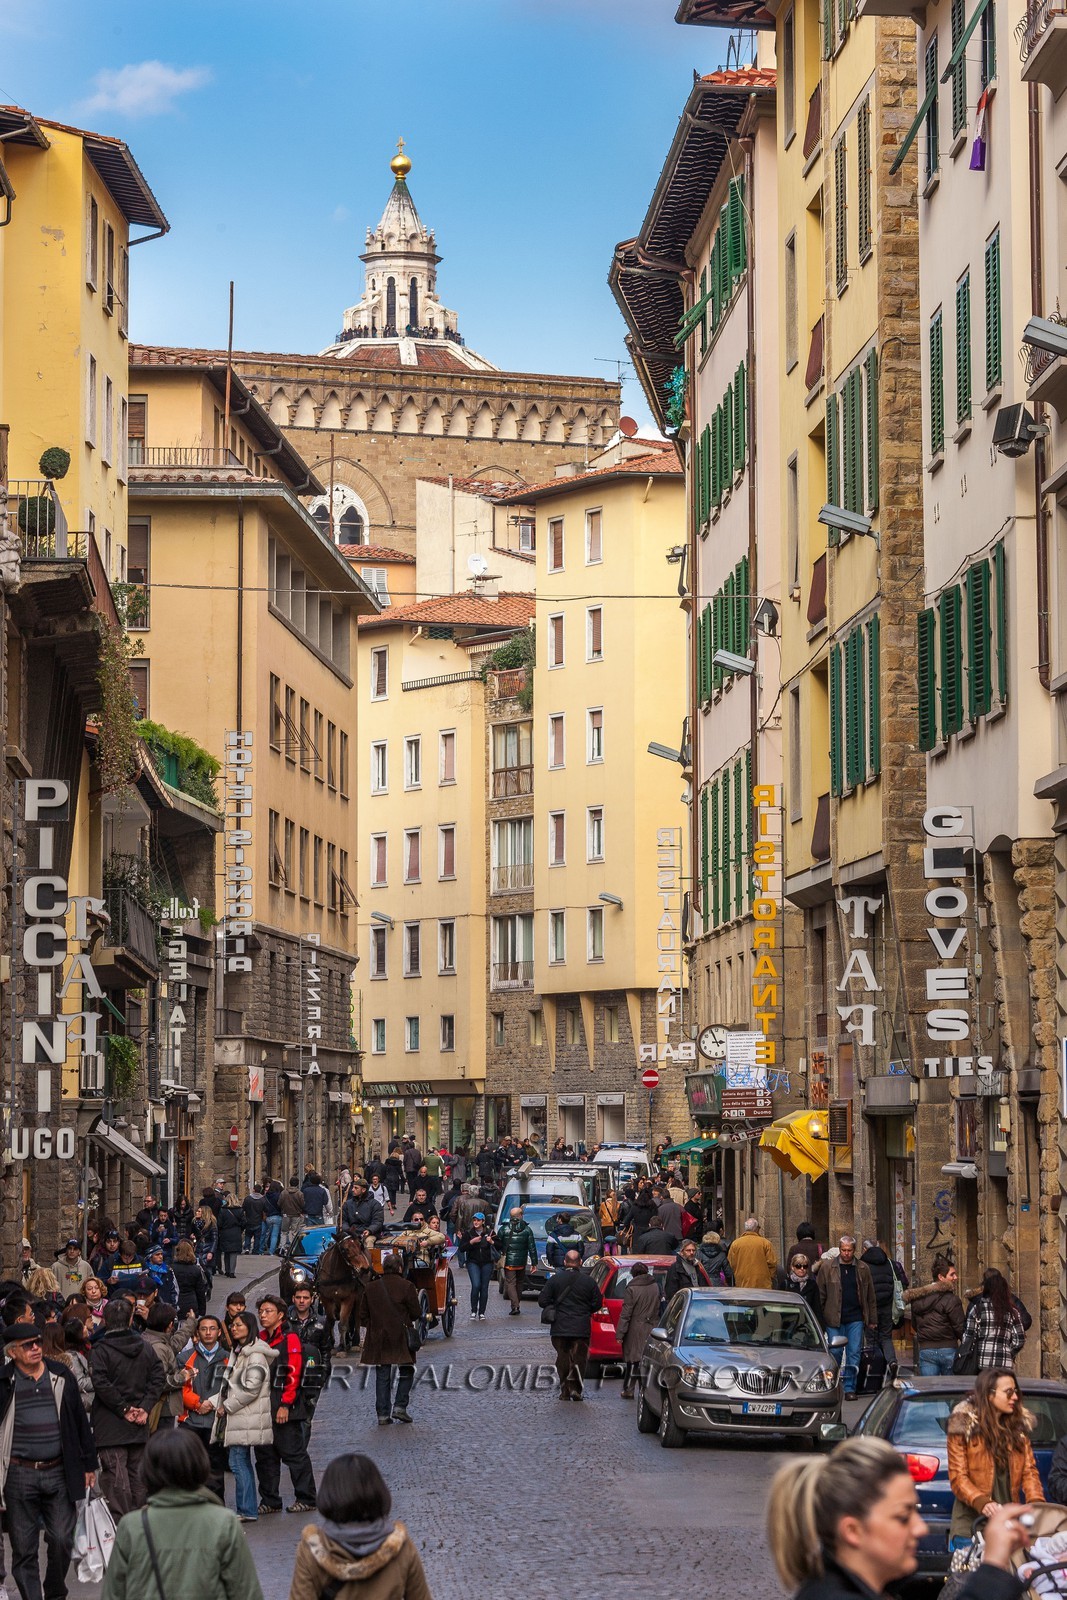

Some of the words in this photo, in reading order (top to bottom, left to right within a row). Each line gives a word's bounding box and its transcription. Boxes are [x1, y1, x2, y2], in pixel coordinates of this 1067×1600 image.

[22, 779, 68, 1112] PICCINI
[922, 805, 970, 1041] GLOVES
[924, 1056, 994, 1077] TIES
[12, 1128, 75, 1159] UGO
